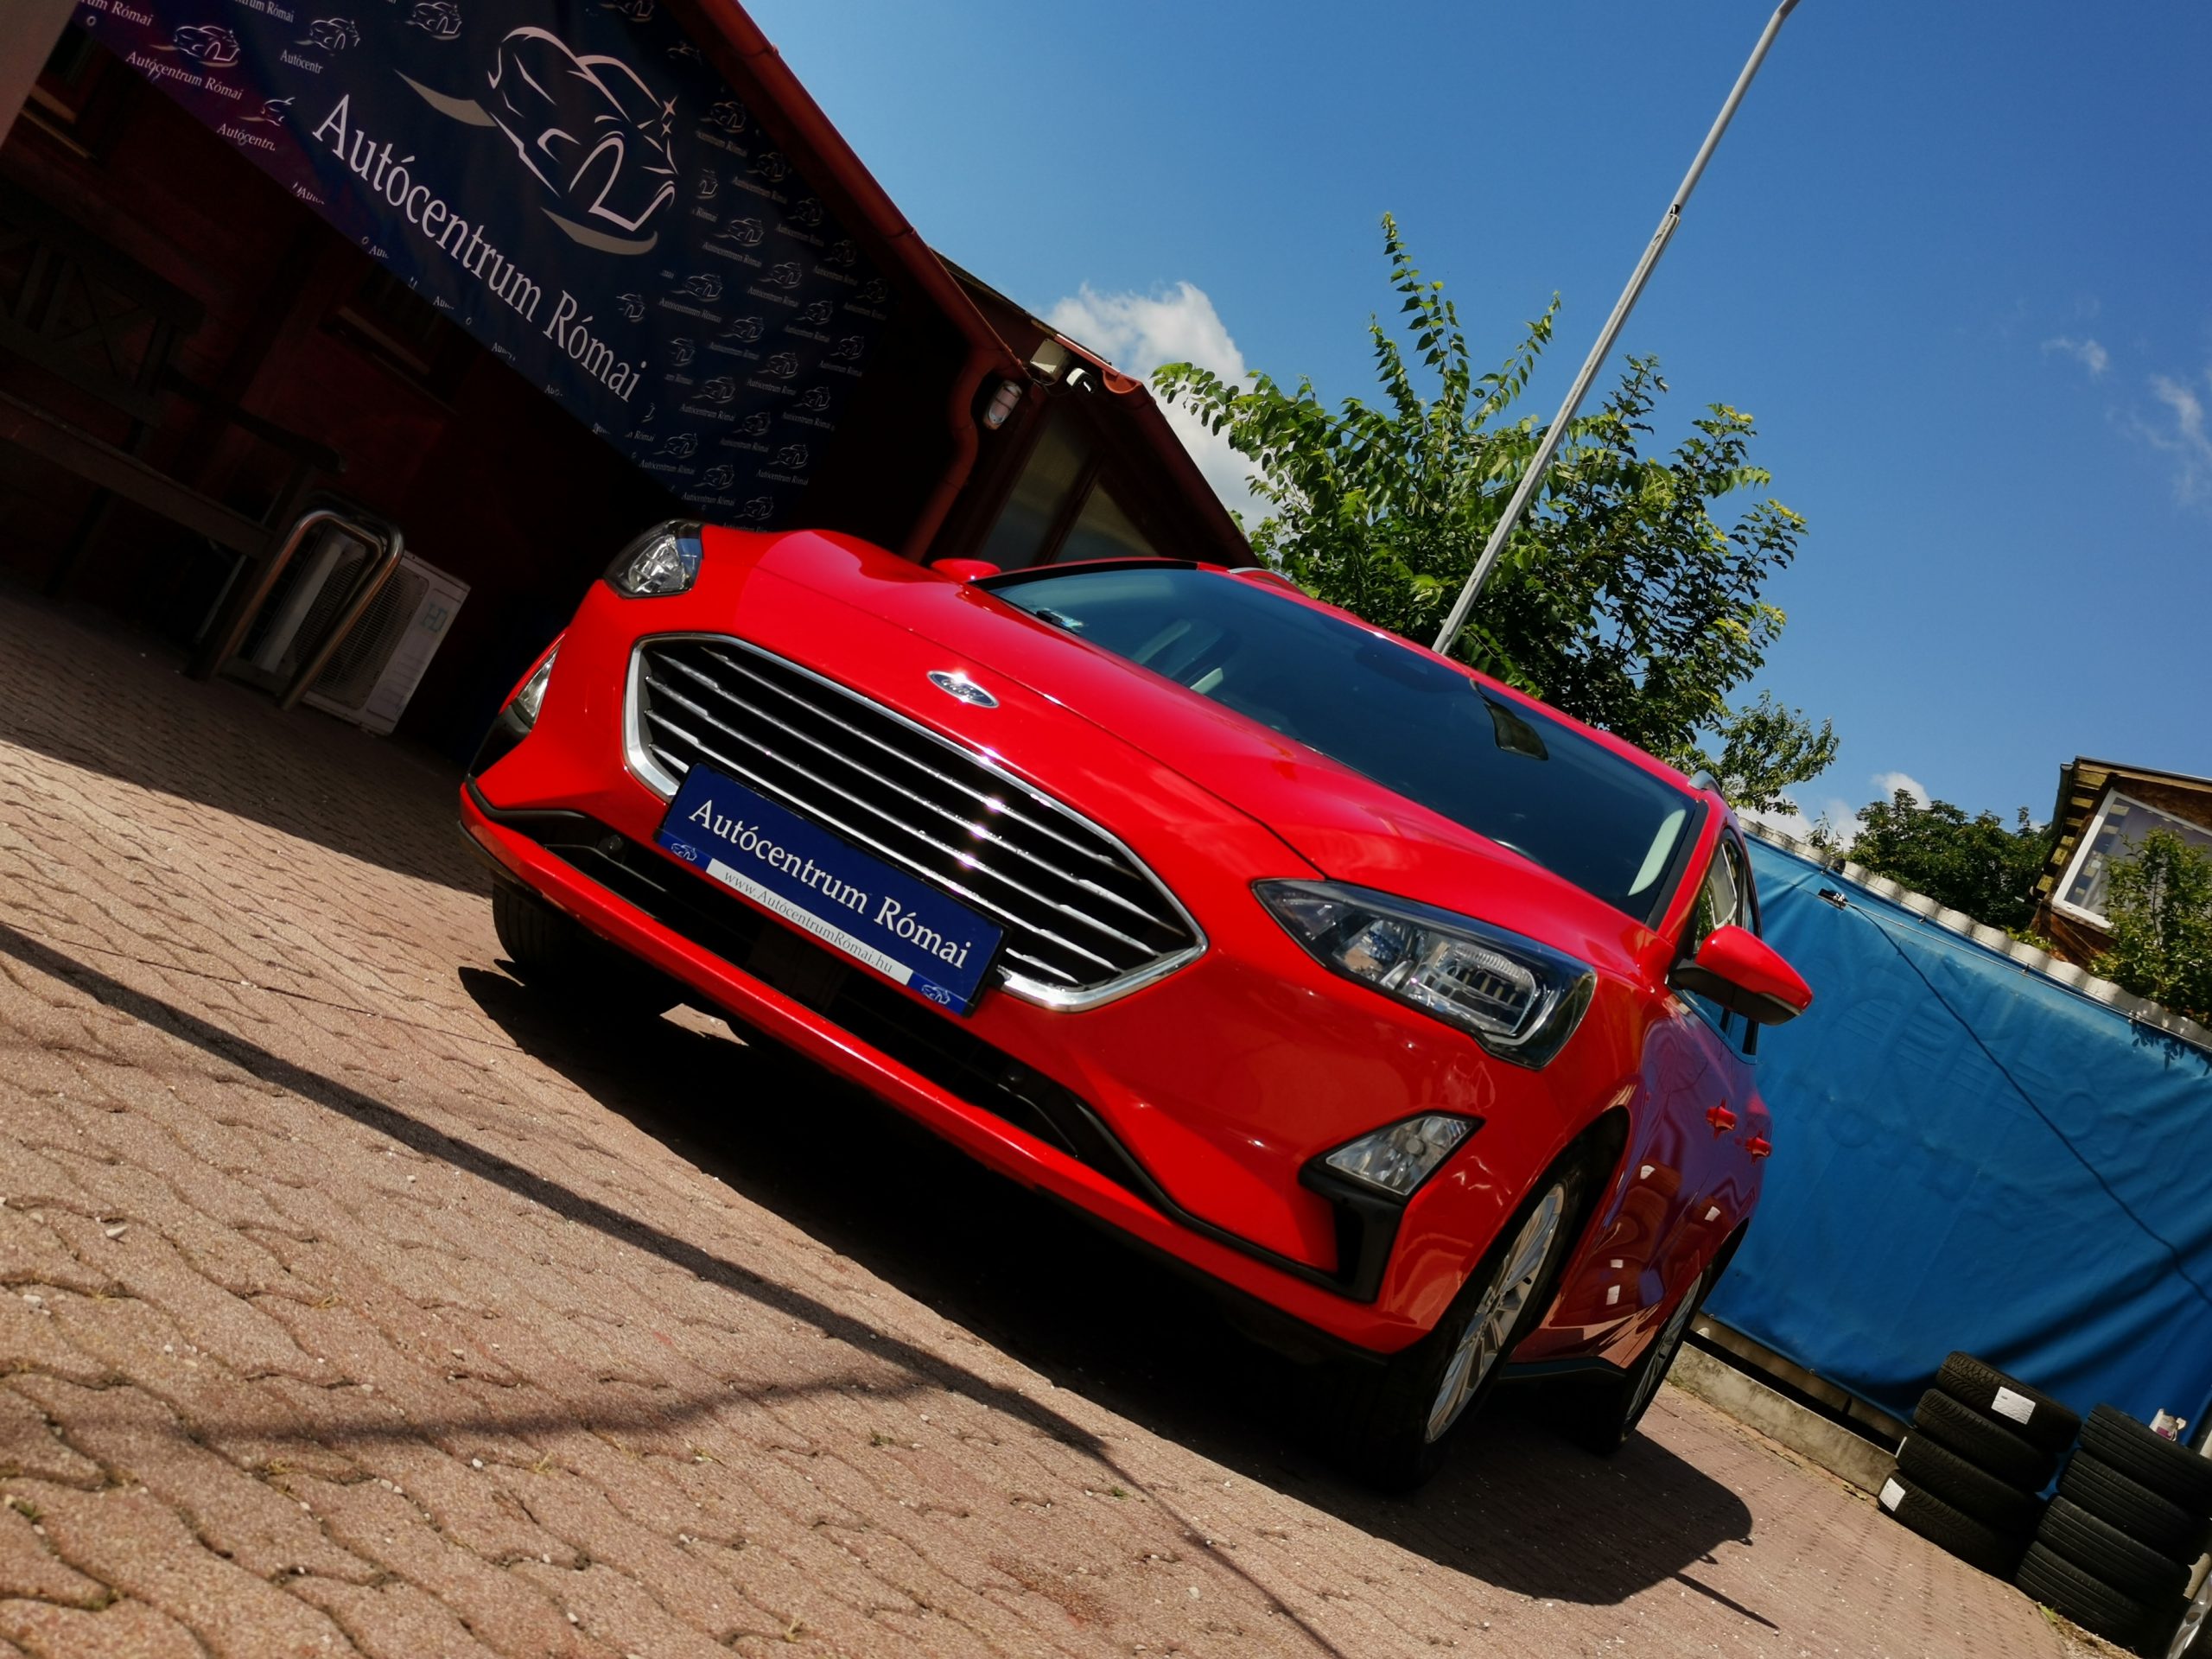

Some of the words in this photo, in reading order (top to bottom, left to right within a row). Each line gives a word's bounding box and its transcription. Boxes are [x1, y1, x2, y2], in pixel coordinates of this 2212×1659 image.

[111, 1, 154, 27] Római
[266, 3, 295, 23] Római
[125, 51, 202, 87] Autócentrum
[205, 77, 244, 101] Római
[312, 94, 541, 323] Autócentrum
[543, 289, 647, 403] Római
[689, 799, 868, 915] Autócentrum
[874, 896, 972, 969] Római
[724, 871, 893, 974] www.AutócentrumRómai.hu
